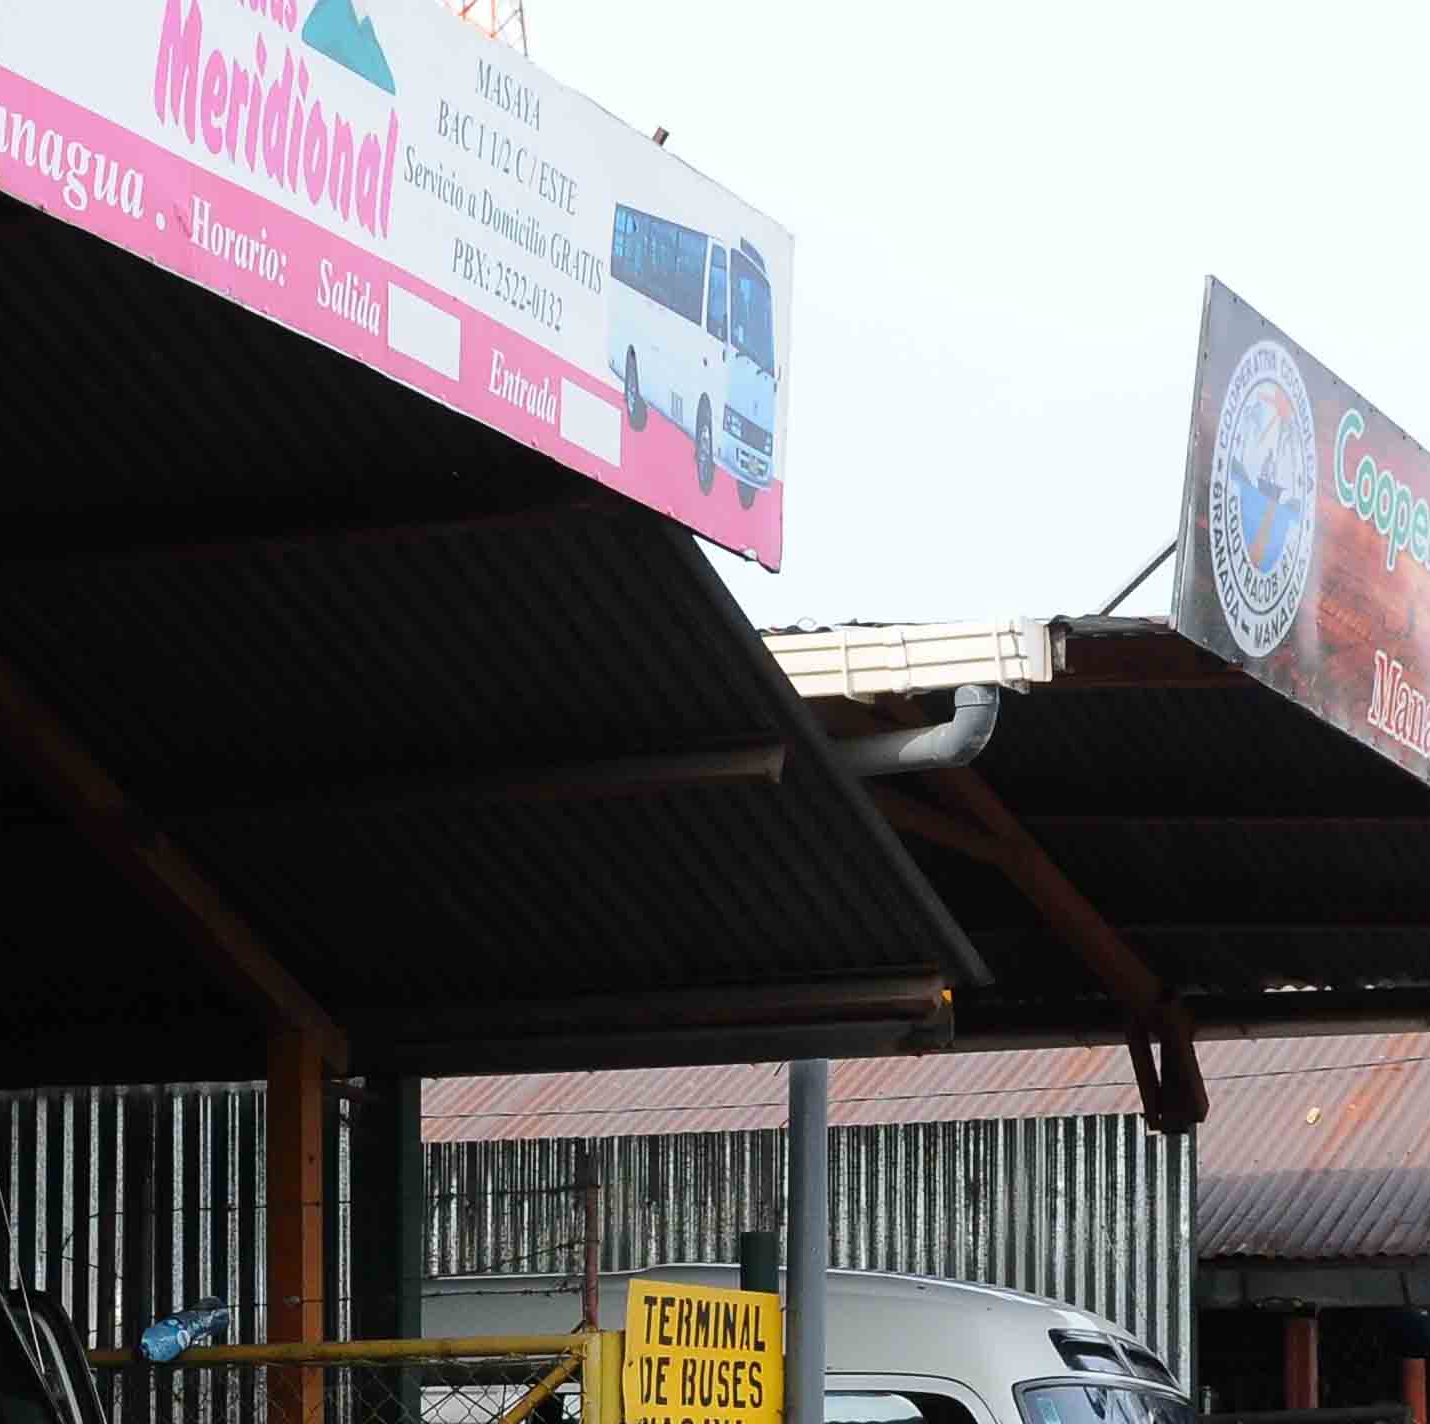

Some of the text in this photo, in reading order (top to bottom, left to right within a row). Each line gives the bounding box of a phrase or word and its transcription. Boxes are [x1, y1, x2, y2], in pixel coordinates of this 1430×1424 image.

[155, 0, 399, 240] Meridional
[475, 57, 540, 131] MASAYA
[438, 98, 474, 152] BAC
[538, 161, 578, 216] ESTE
[404, 144, 604, 295] Servicio a Domicilio GRATIS
[189, 193, 558, 427] Horario: Salida Entrada
[453, 236, 564, 333] PBX: 2522-0132
[1212, 481, 1241, 628] GRANADA
[639, 1356, 763, 1408] DE BUSES
[643, 1295, 766, 1352] TERMINAL
